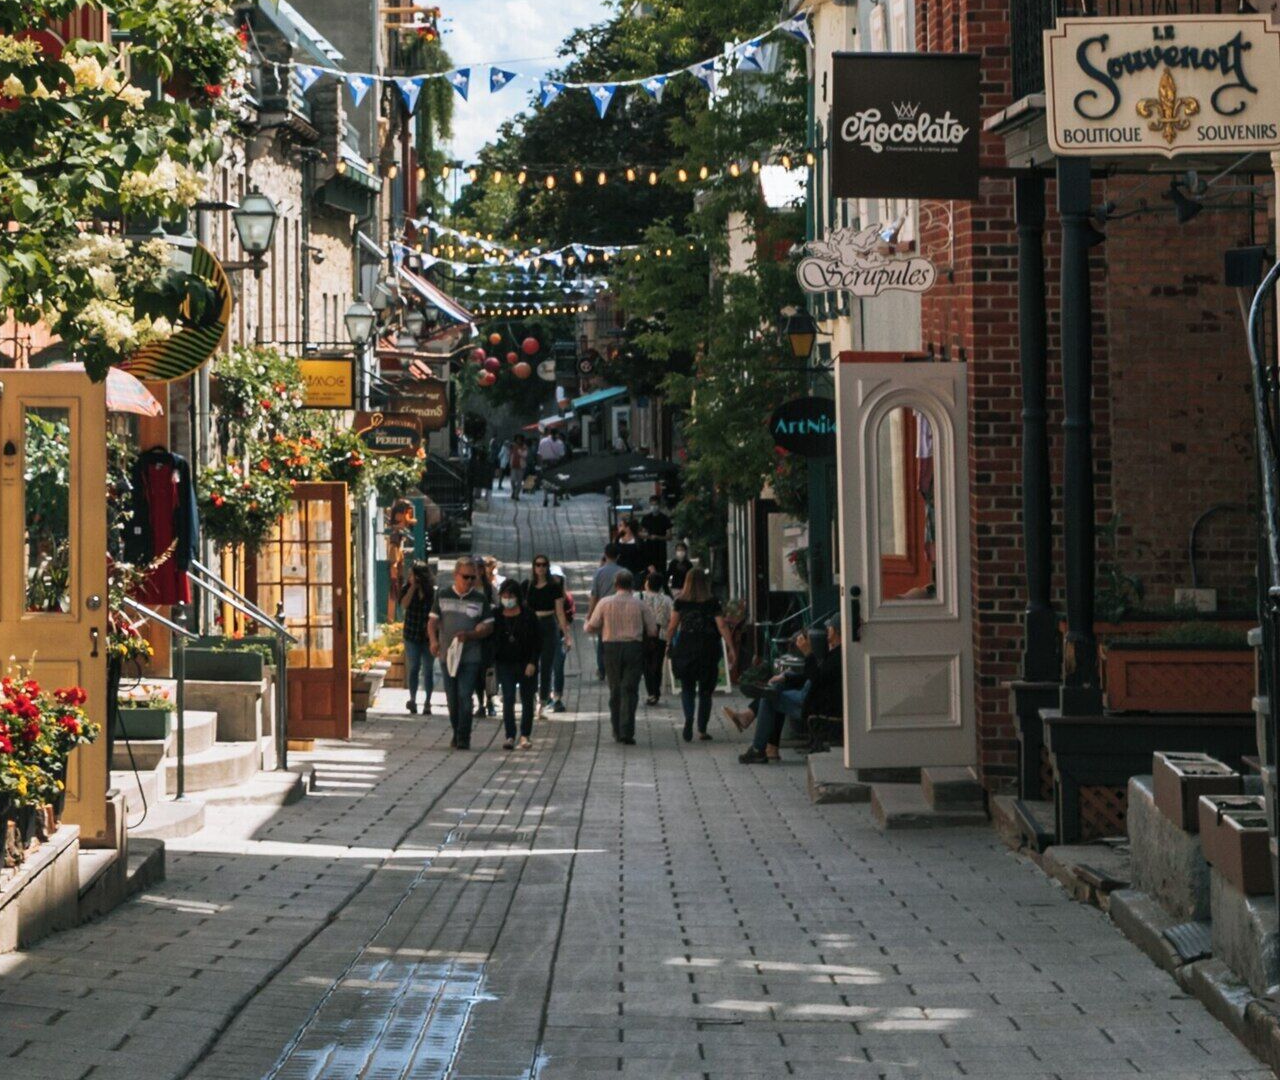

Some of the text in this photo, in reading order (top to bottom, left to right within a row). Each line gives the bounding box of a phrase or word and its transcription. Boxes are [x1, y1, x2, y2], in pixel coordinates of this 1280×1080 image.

[1153, 25, 1175, 40] LE
[841, 108, 970, 153] Chocolato
[1064, 124, 1277, 144] BOUTIQUE SOUVENIRS
[803, 261, 929, 294] Scrupules
[375, 436, 413, 448] PERRIER
